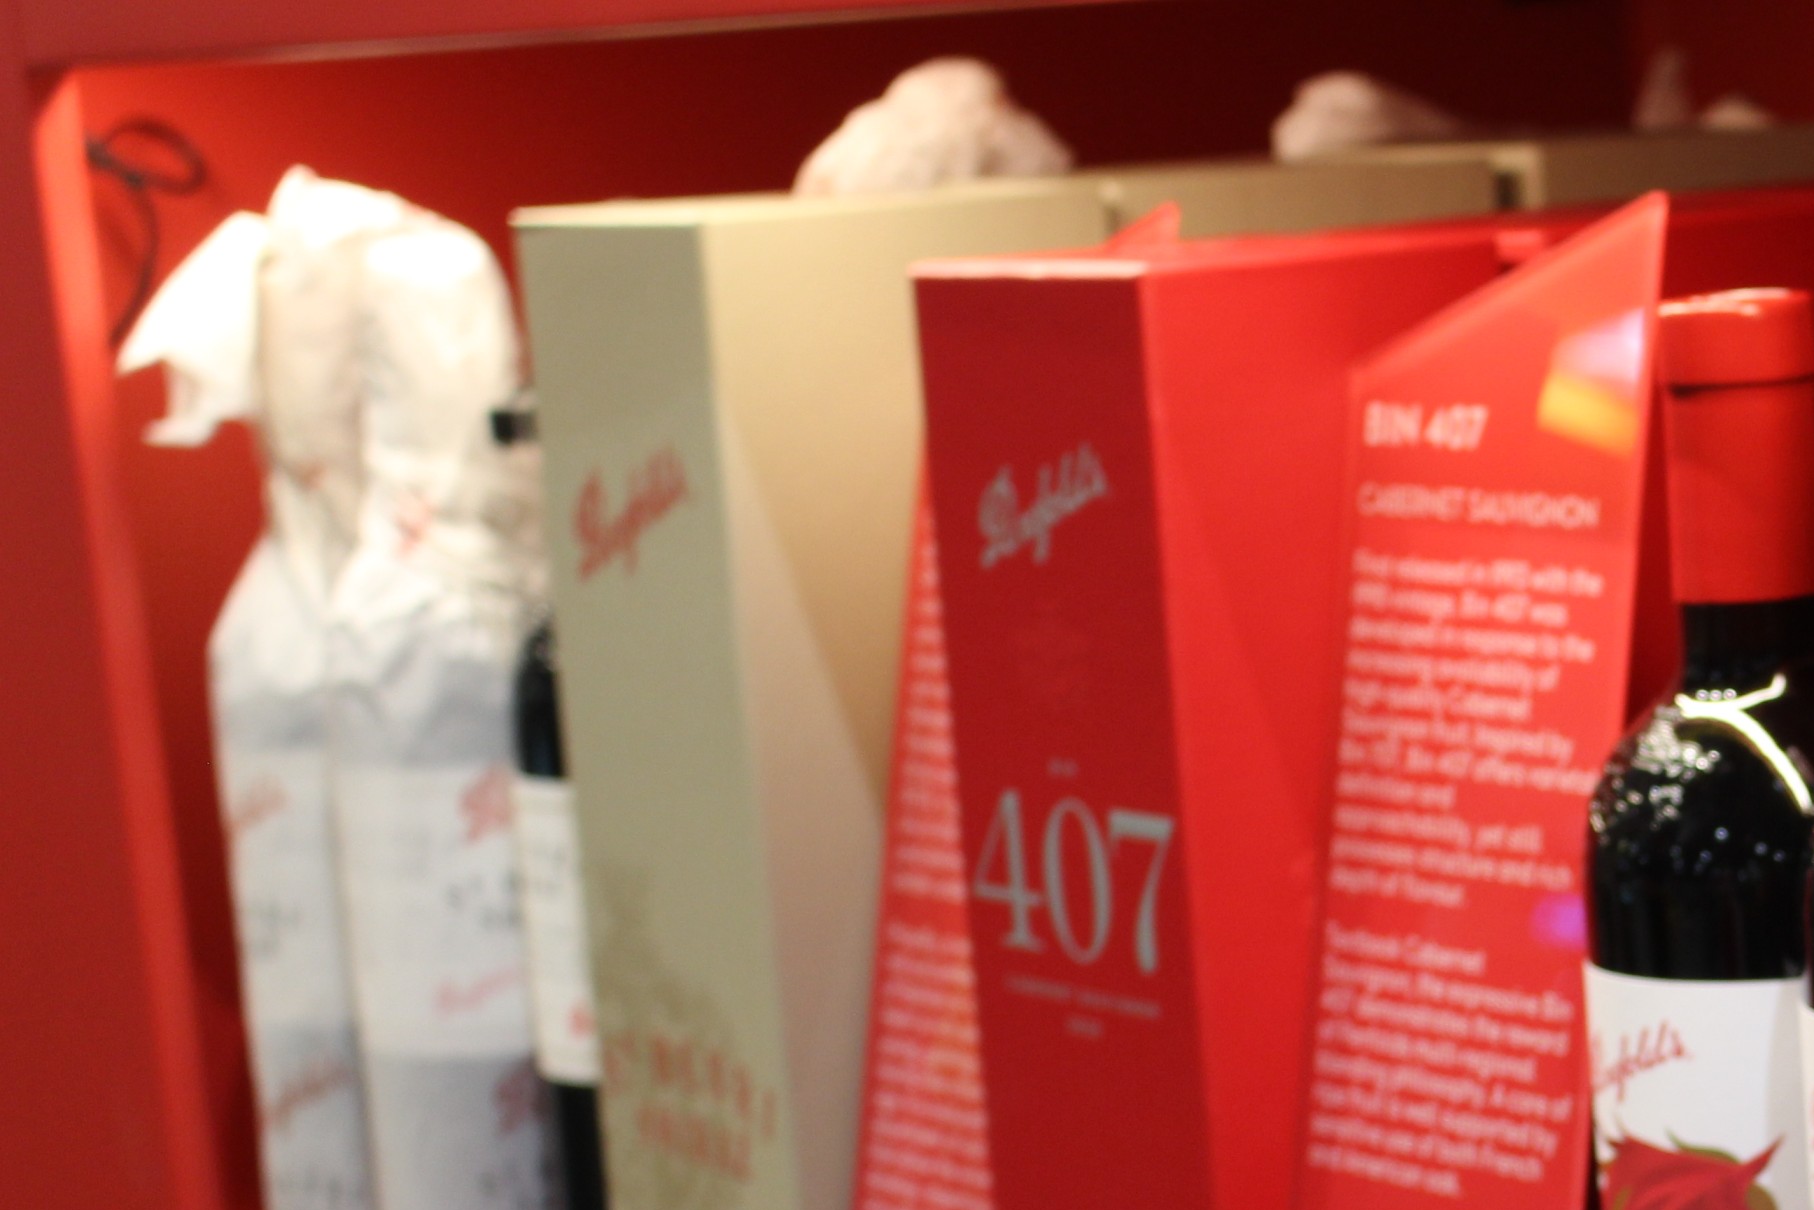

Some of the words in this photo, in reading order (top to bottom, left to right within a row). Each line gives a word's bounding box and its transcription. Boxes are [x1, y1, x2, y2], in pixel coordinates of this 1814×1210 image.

[1364, 399, 1422, 448] BIN
[1425, 403, 1489, 450] 407
[972, 789, 1175, 975] 407
